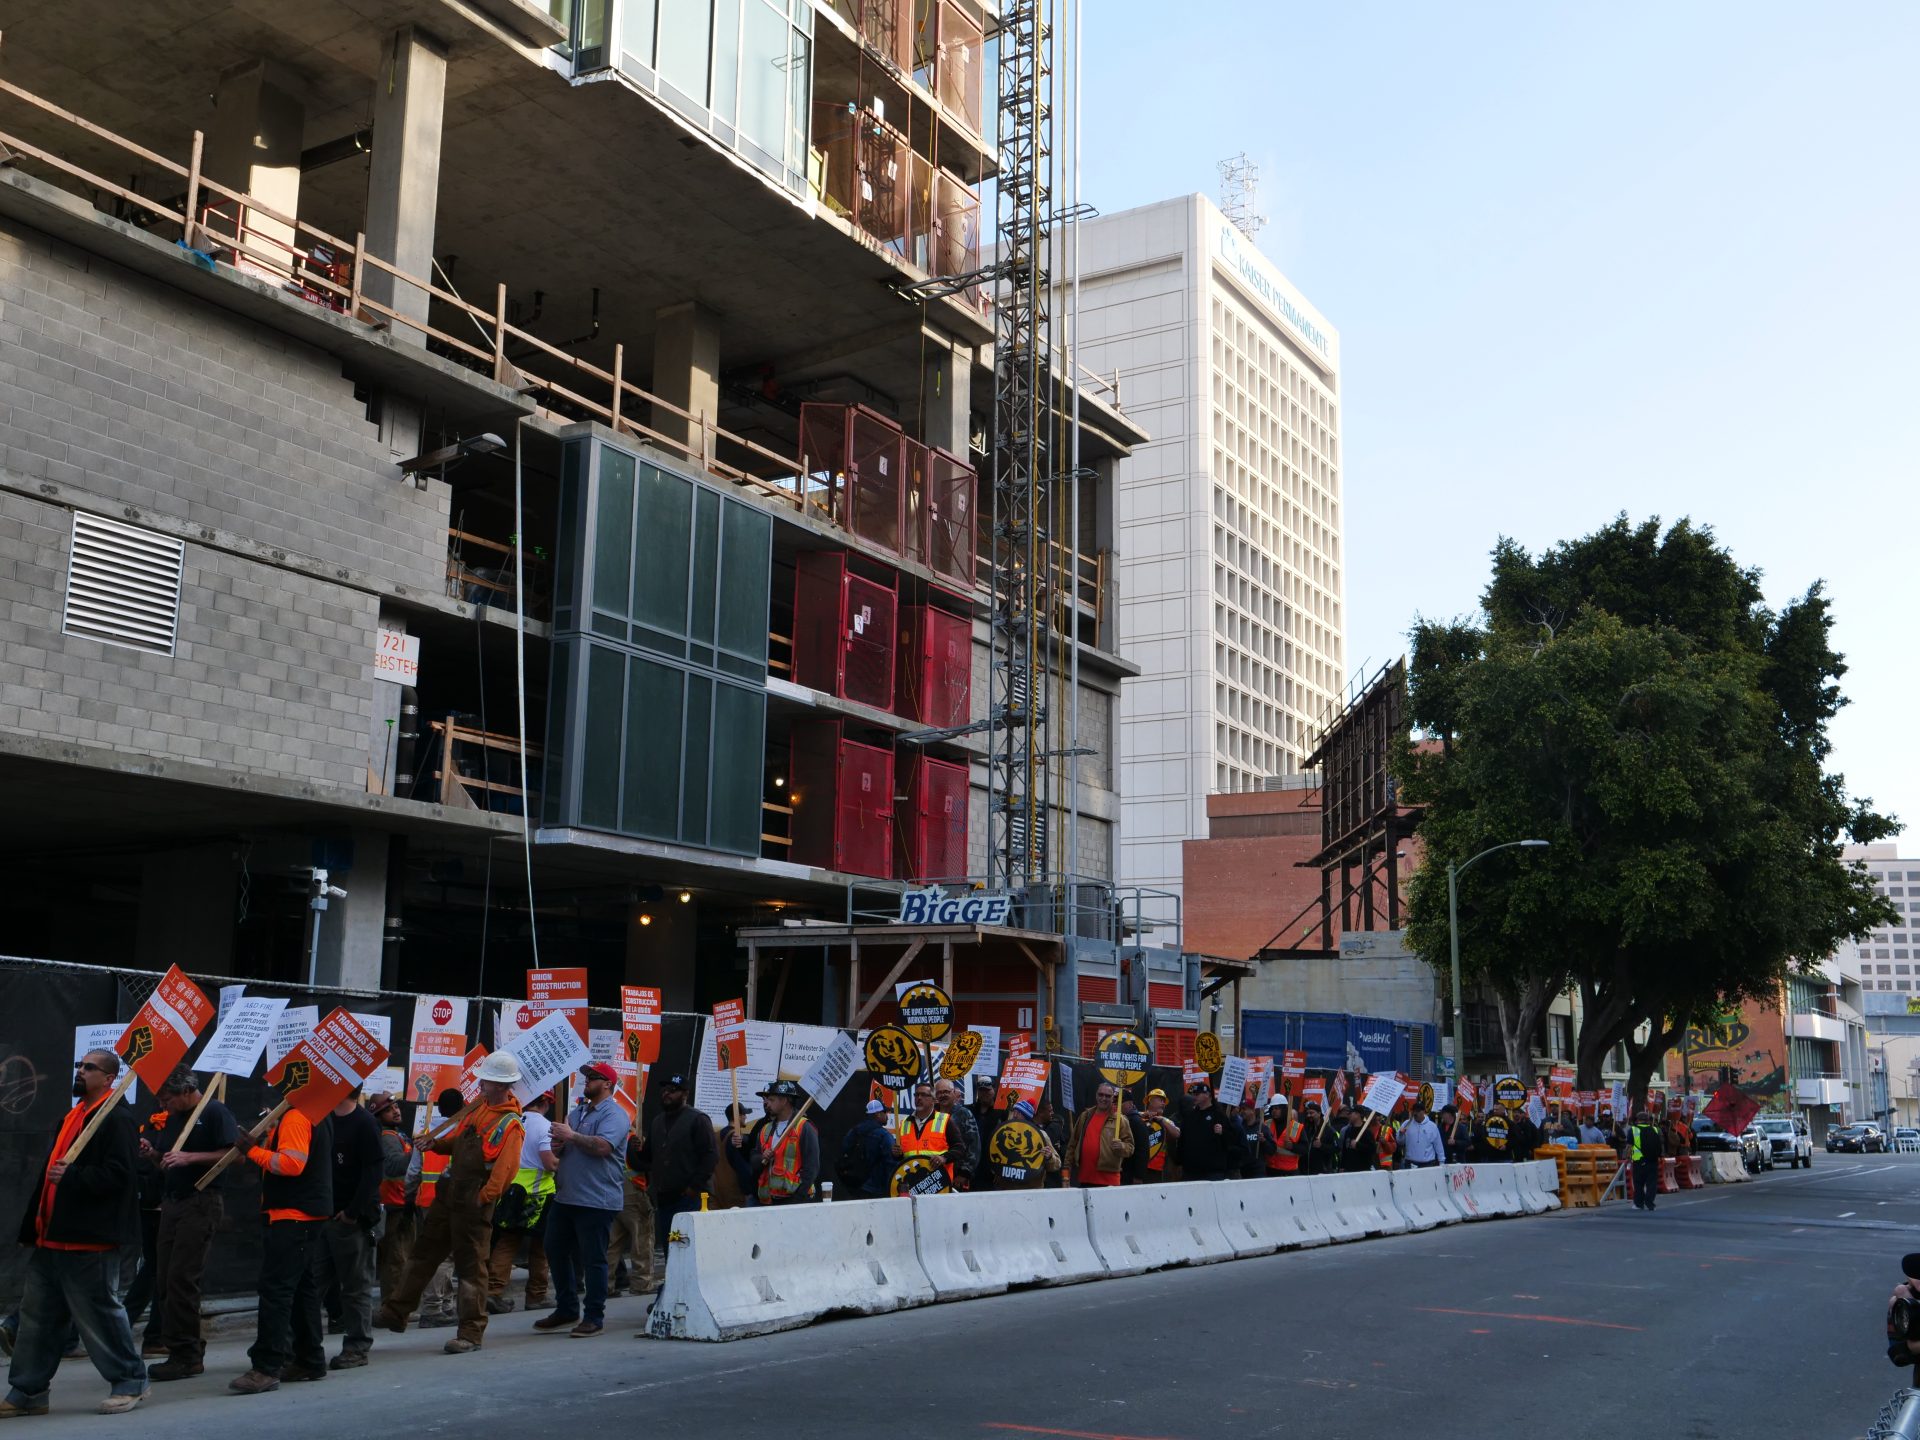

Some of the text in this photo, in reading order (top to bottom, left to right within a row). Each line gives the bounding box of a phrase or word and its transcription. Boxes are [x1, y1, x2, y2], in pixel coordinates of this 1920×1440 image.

[1239, 254, 1328, 358] KAISER PERMANENTE
[856, 616, 862, 632] 3
[374, 654, 418, 676] EBSTER
[532, 982, 582, 990] CONSTRUCTION
[433, 1008, 452, 1018] STOP
[517, 1012, 529, 1023] STO
[902, 1008, 910, 1016] THE
[924, 1007, 940, 1016] FIGHTS
[940, 1007, 948, 1015] FOR
[928, 1015, 944, 1023] PEOPLE
[335, 1012, 377, 1053] TRABAJOS DE
[557, 1025, 580, 1053] A&D FIRE
[310, 1036, 329, 1056] PARA
[318, 1028, 358, 1067] DE LA UNIÓN
[326, 1020, 374, 1066] CONSTRUCCIÓN
[532, 1031, 564, 1075] THE AREA STANDARD
[549, 1028, 572, 1059] DOES NOT PAY
[798, 1044, 818, 1052] Webster
[300, 1045, 342, 1085] OAKLANDERS
[524, 1045, 547, 1076] THIS AREA FOR
[1100, 1052, 1109, 1060] THE
[1122, 1053, 1137, 1061] FIGHTS
[1126, 1061, 1142, 1070] PEOPLE
[882, 1075, 905, 1087] IUPAT
[917, 1169, 942, 1191] FIGHTS FOR
[1002, 1166, 1027, 1180] IUPAT
